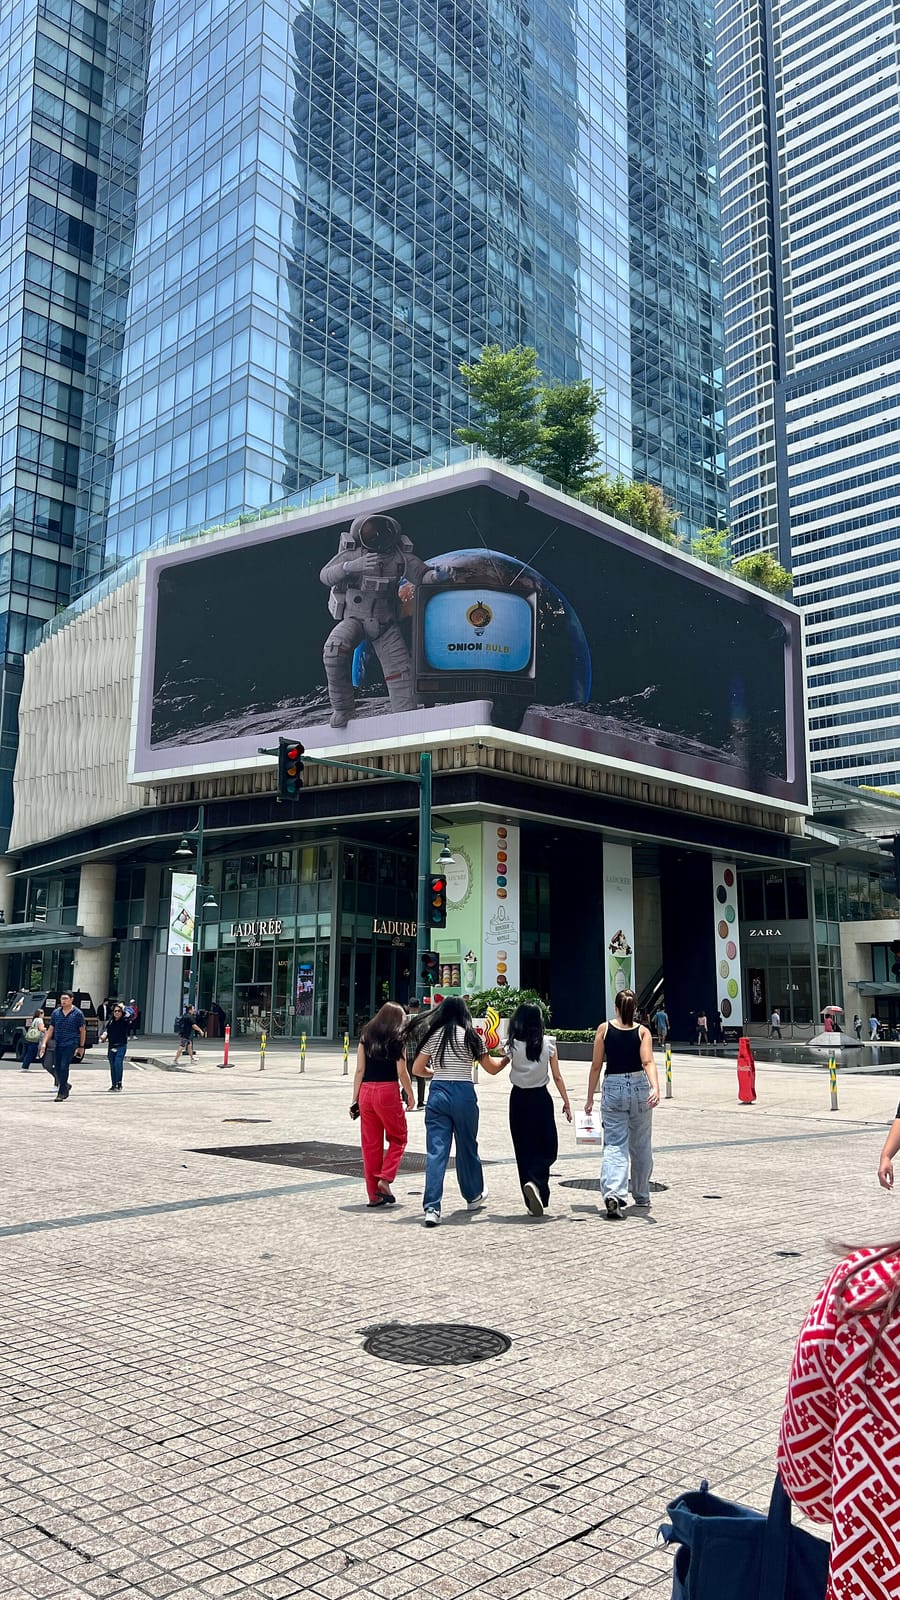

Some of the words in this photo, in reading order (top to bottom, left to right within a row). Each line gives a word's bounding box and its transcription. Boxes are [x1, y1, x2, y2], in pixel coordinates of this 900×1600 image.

[447, 643, 482, 651] ONION
[486, 644, 509, 653] BULB
[230, 918, 282, 937] LADURÉE
[372, 919, 417, 937] LADURÉ
[749, 929, 782, 937] ZARA
